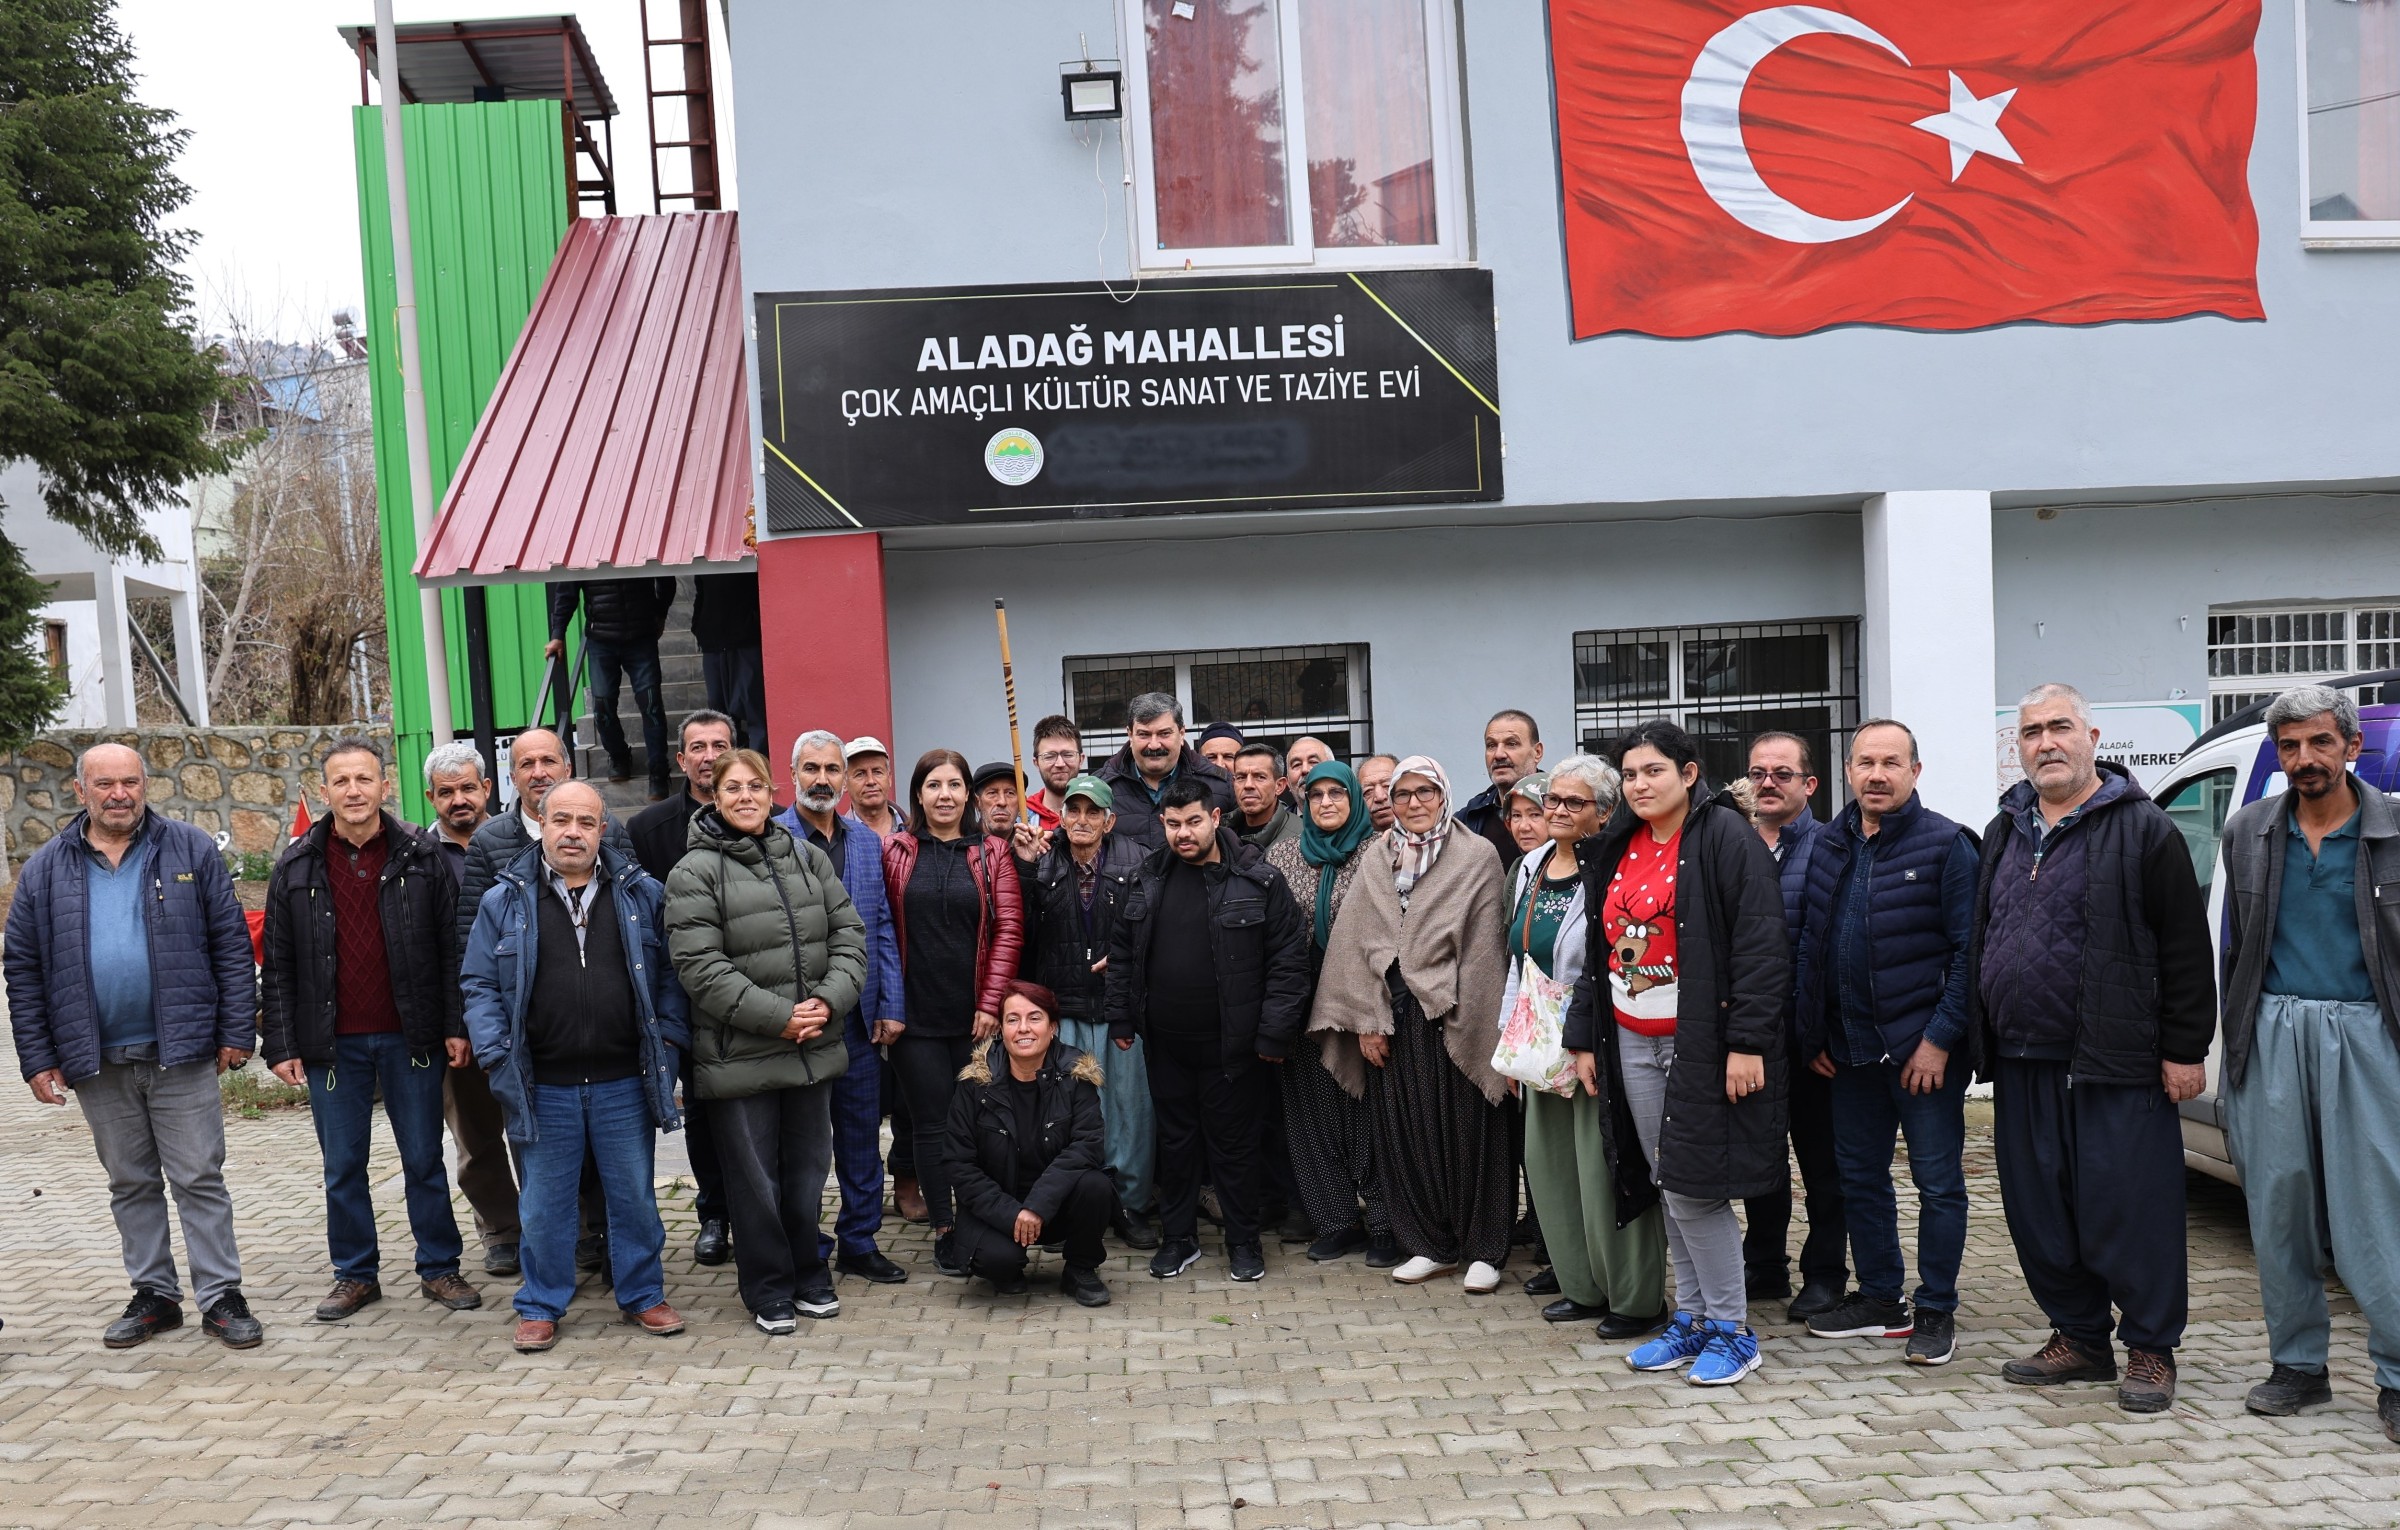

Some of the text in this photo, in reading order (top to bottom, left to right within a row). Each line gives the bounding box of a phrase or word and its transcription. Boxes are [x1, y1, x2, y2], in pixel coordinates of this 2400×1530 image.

[916, 313, 1345, 372] ALADAĞ MAHALLESİ
[841, 364, 1420, 427] ÇOK AMAÇLI KÜLTÜR SANAT VE TAZİYE EVİ
[2098, 740, 2134, 750] ALADAĞ
